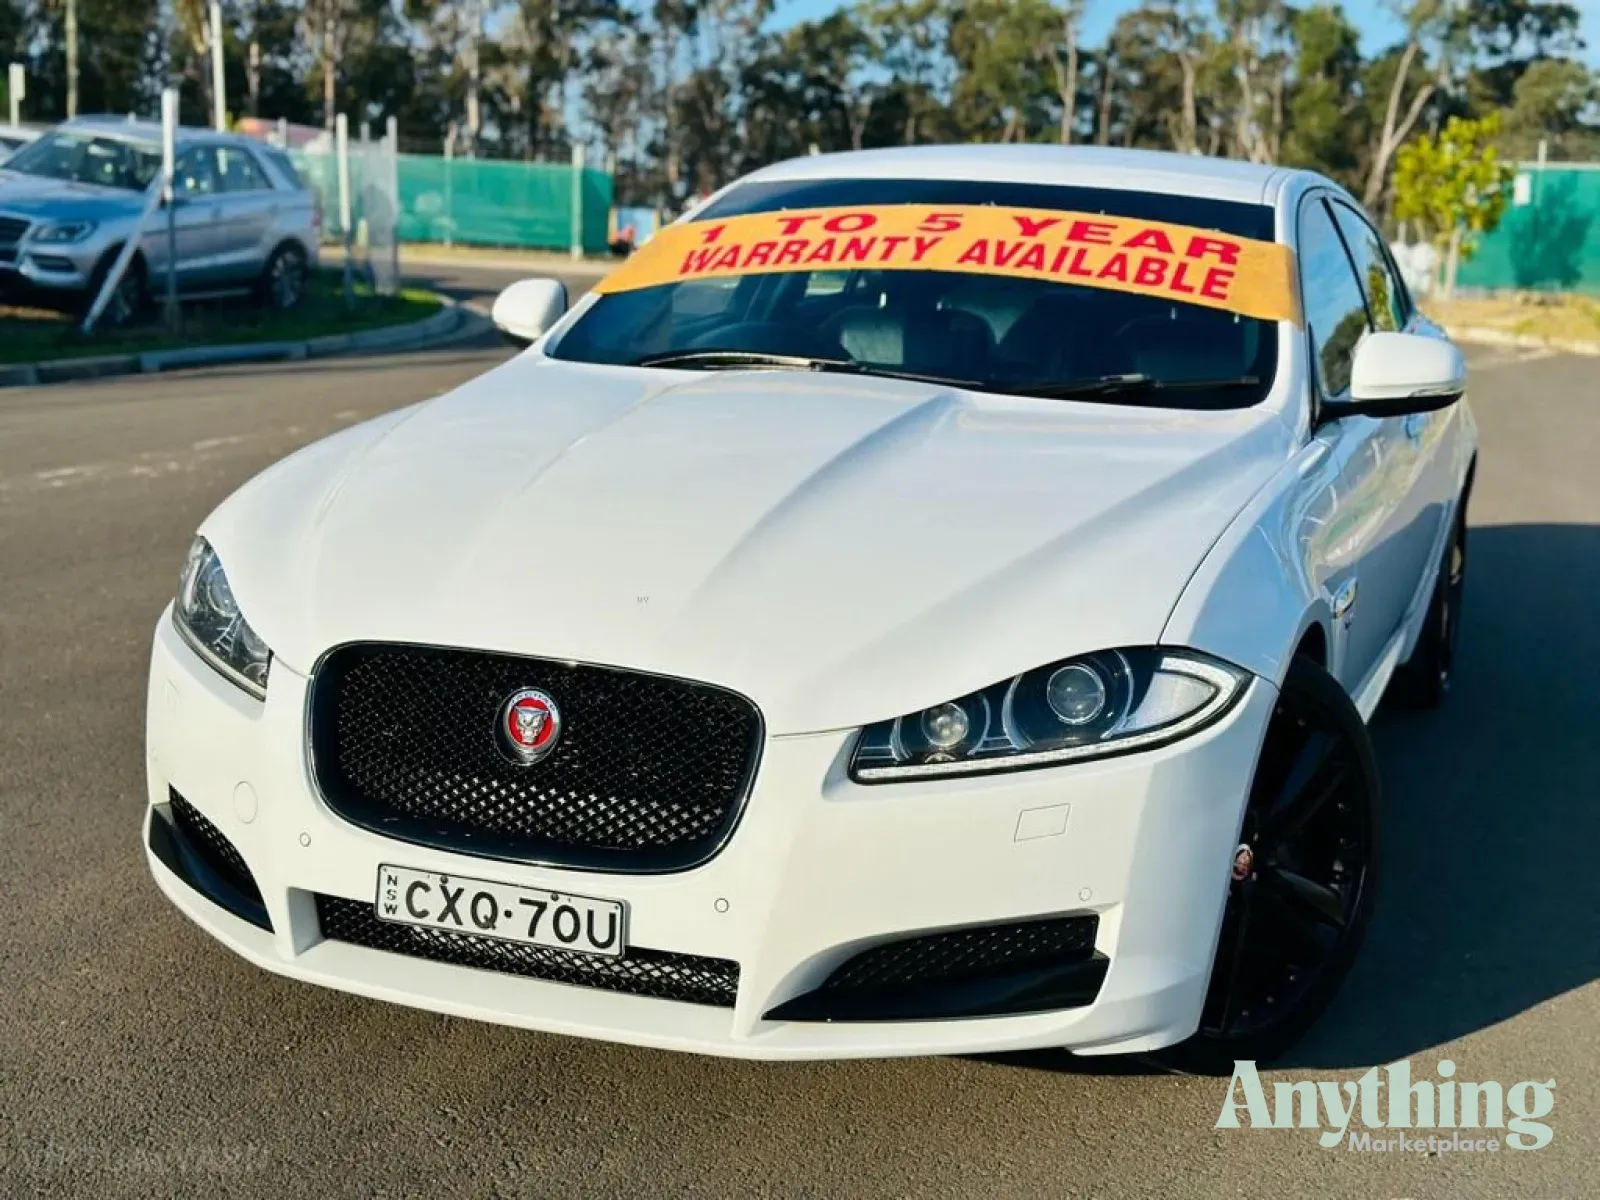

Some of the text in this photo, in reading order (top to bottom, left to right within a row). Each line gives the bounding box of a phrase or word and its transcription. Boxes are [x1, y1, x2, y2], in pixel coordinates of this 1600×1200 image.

[679, 236, 1236, 301] WARRANTY AVAILABLE
[701, 213, 1242, 266] 1 TO 5 YEAR
